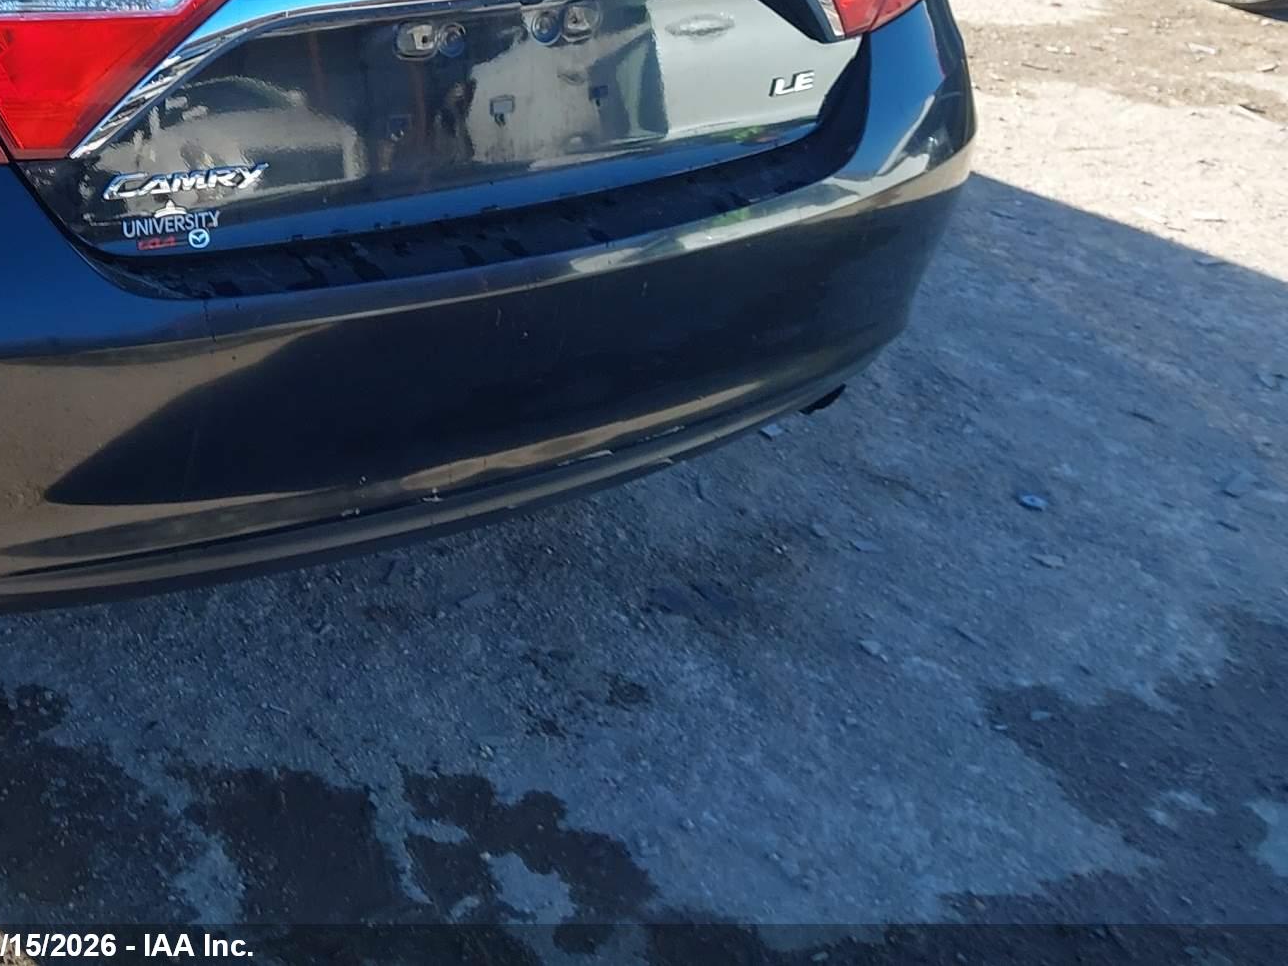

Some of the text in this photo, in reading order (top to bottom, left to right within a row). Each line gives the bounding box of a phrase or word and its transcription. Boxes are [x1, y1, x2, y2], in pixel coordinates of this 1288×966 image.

[768, 69, 816, 97] LE
[103, 163, 269, 200] CAMRY
[123, 211, 220, 238] UNIVERSITY
